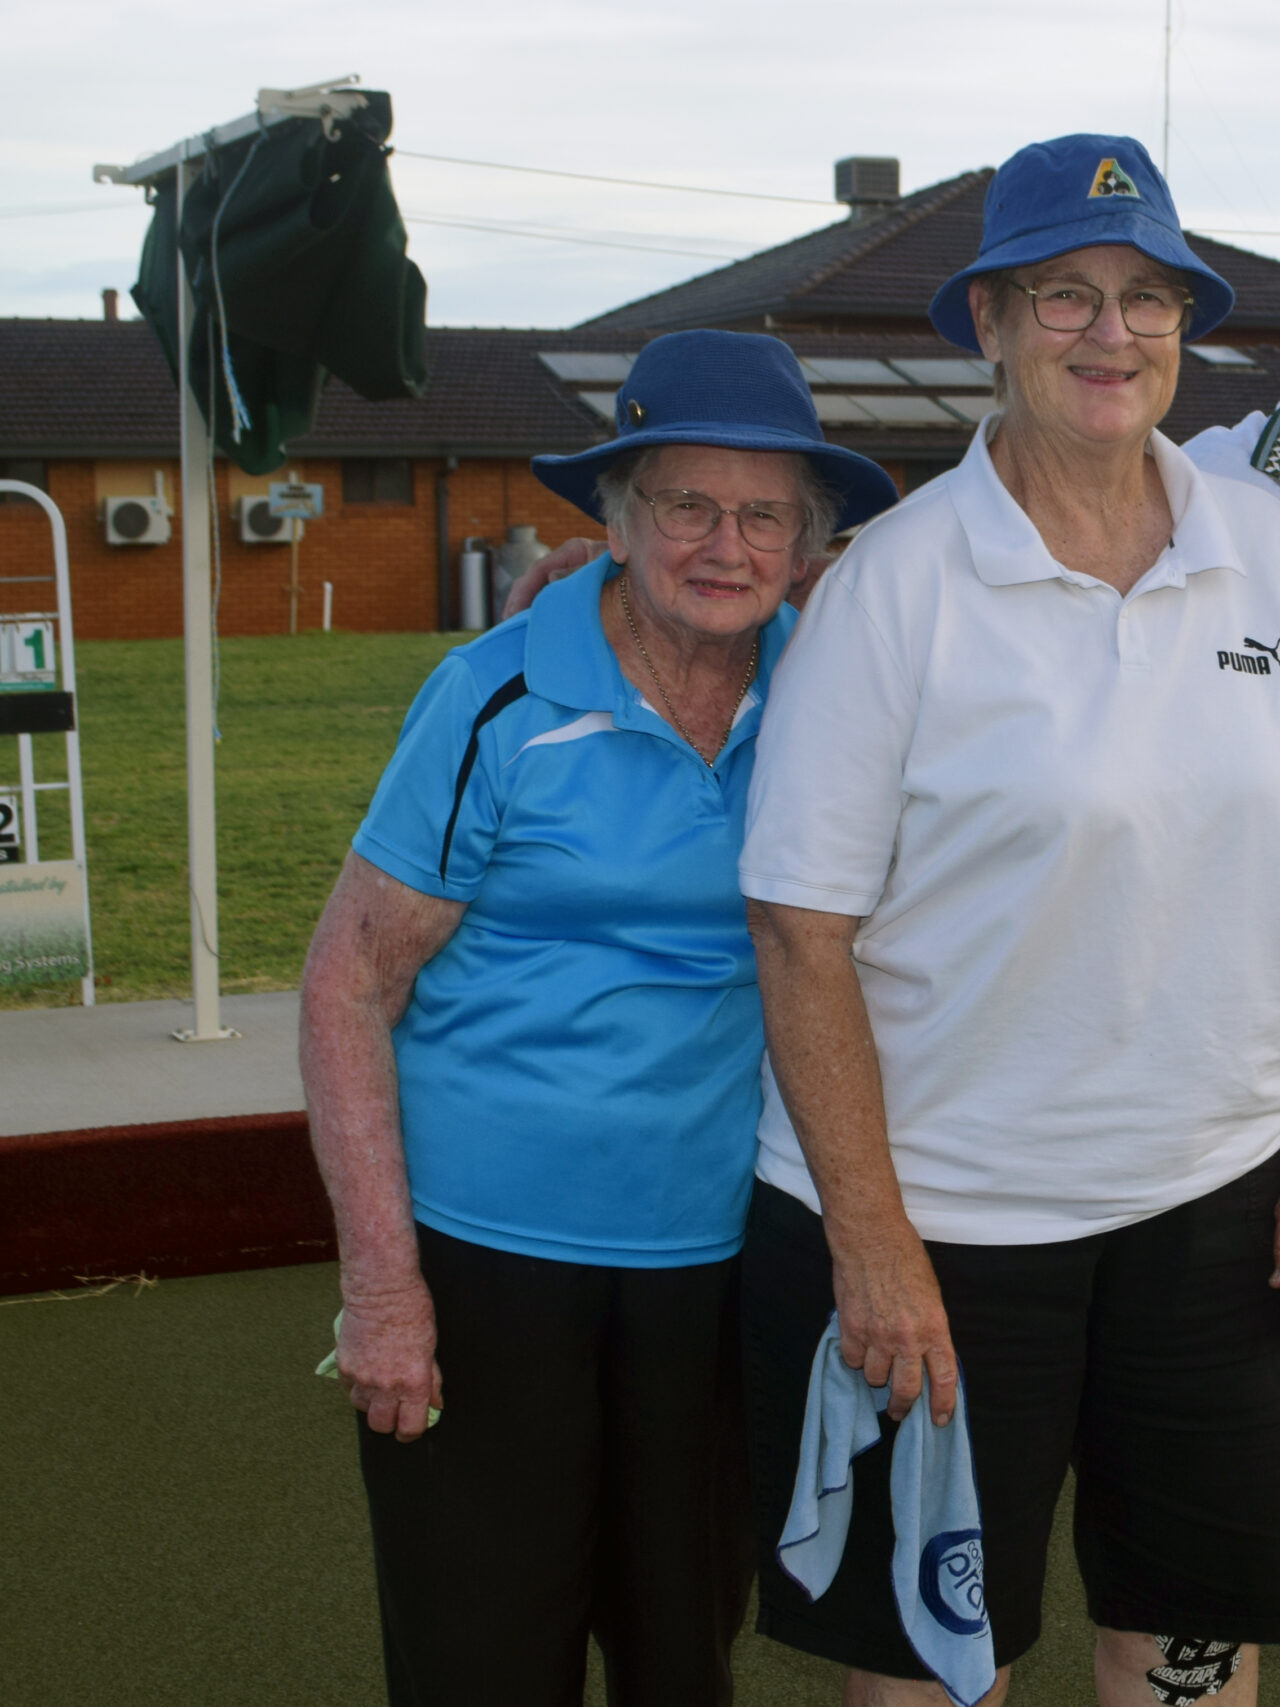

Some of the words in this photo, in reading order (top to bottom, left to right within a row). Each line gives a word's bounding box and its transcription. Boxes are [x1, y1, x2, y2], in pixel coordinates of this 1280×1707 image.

[24, 628, 46, 669] 1
[1217, 650, 1271, 675] PUMA
[1152, 1664, 1221, 1685] ROCKTAPE
